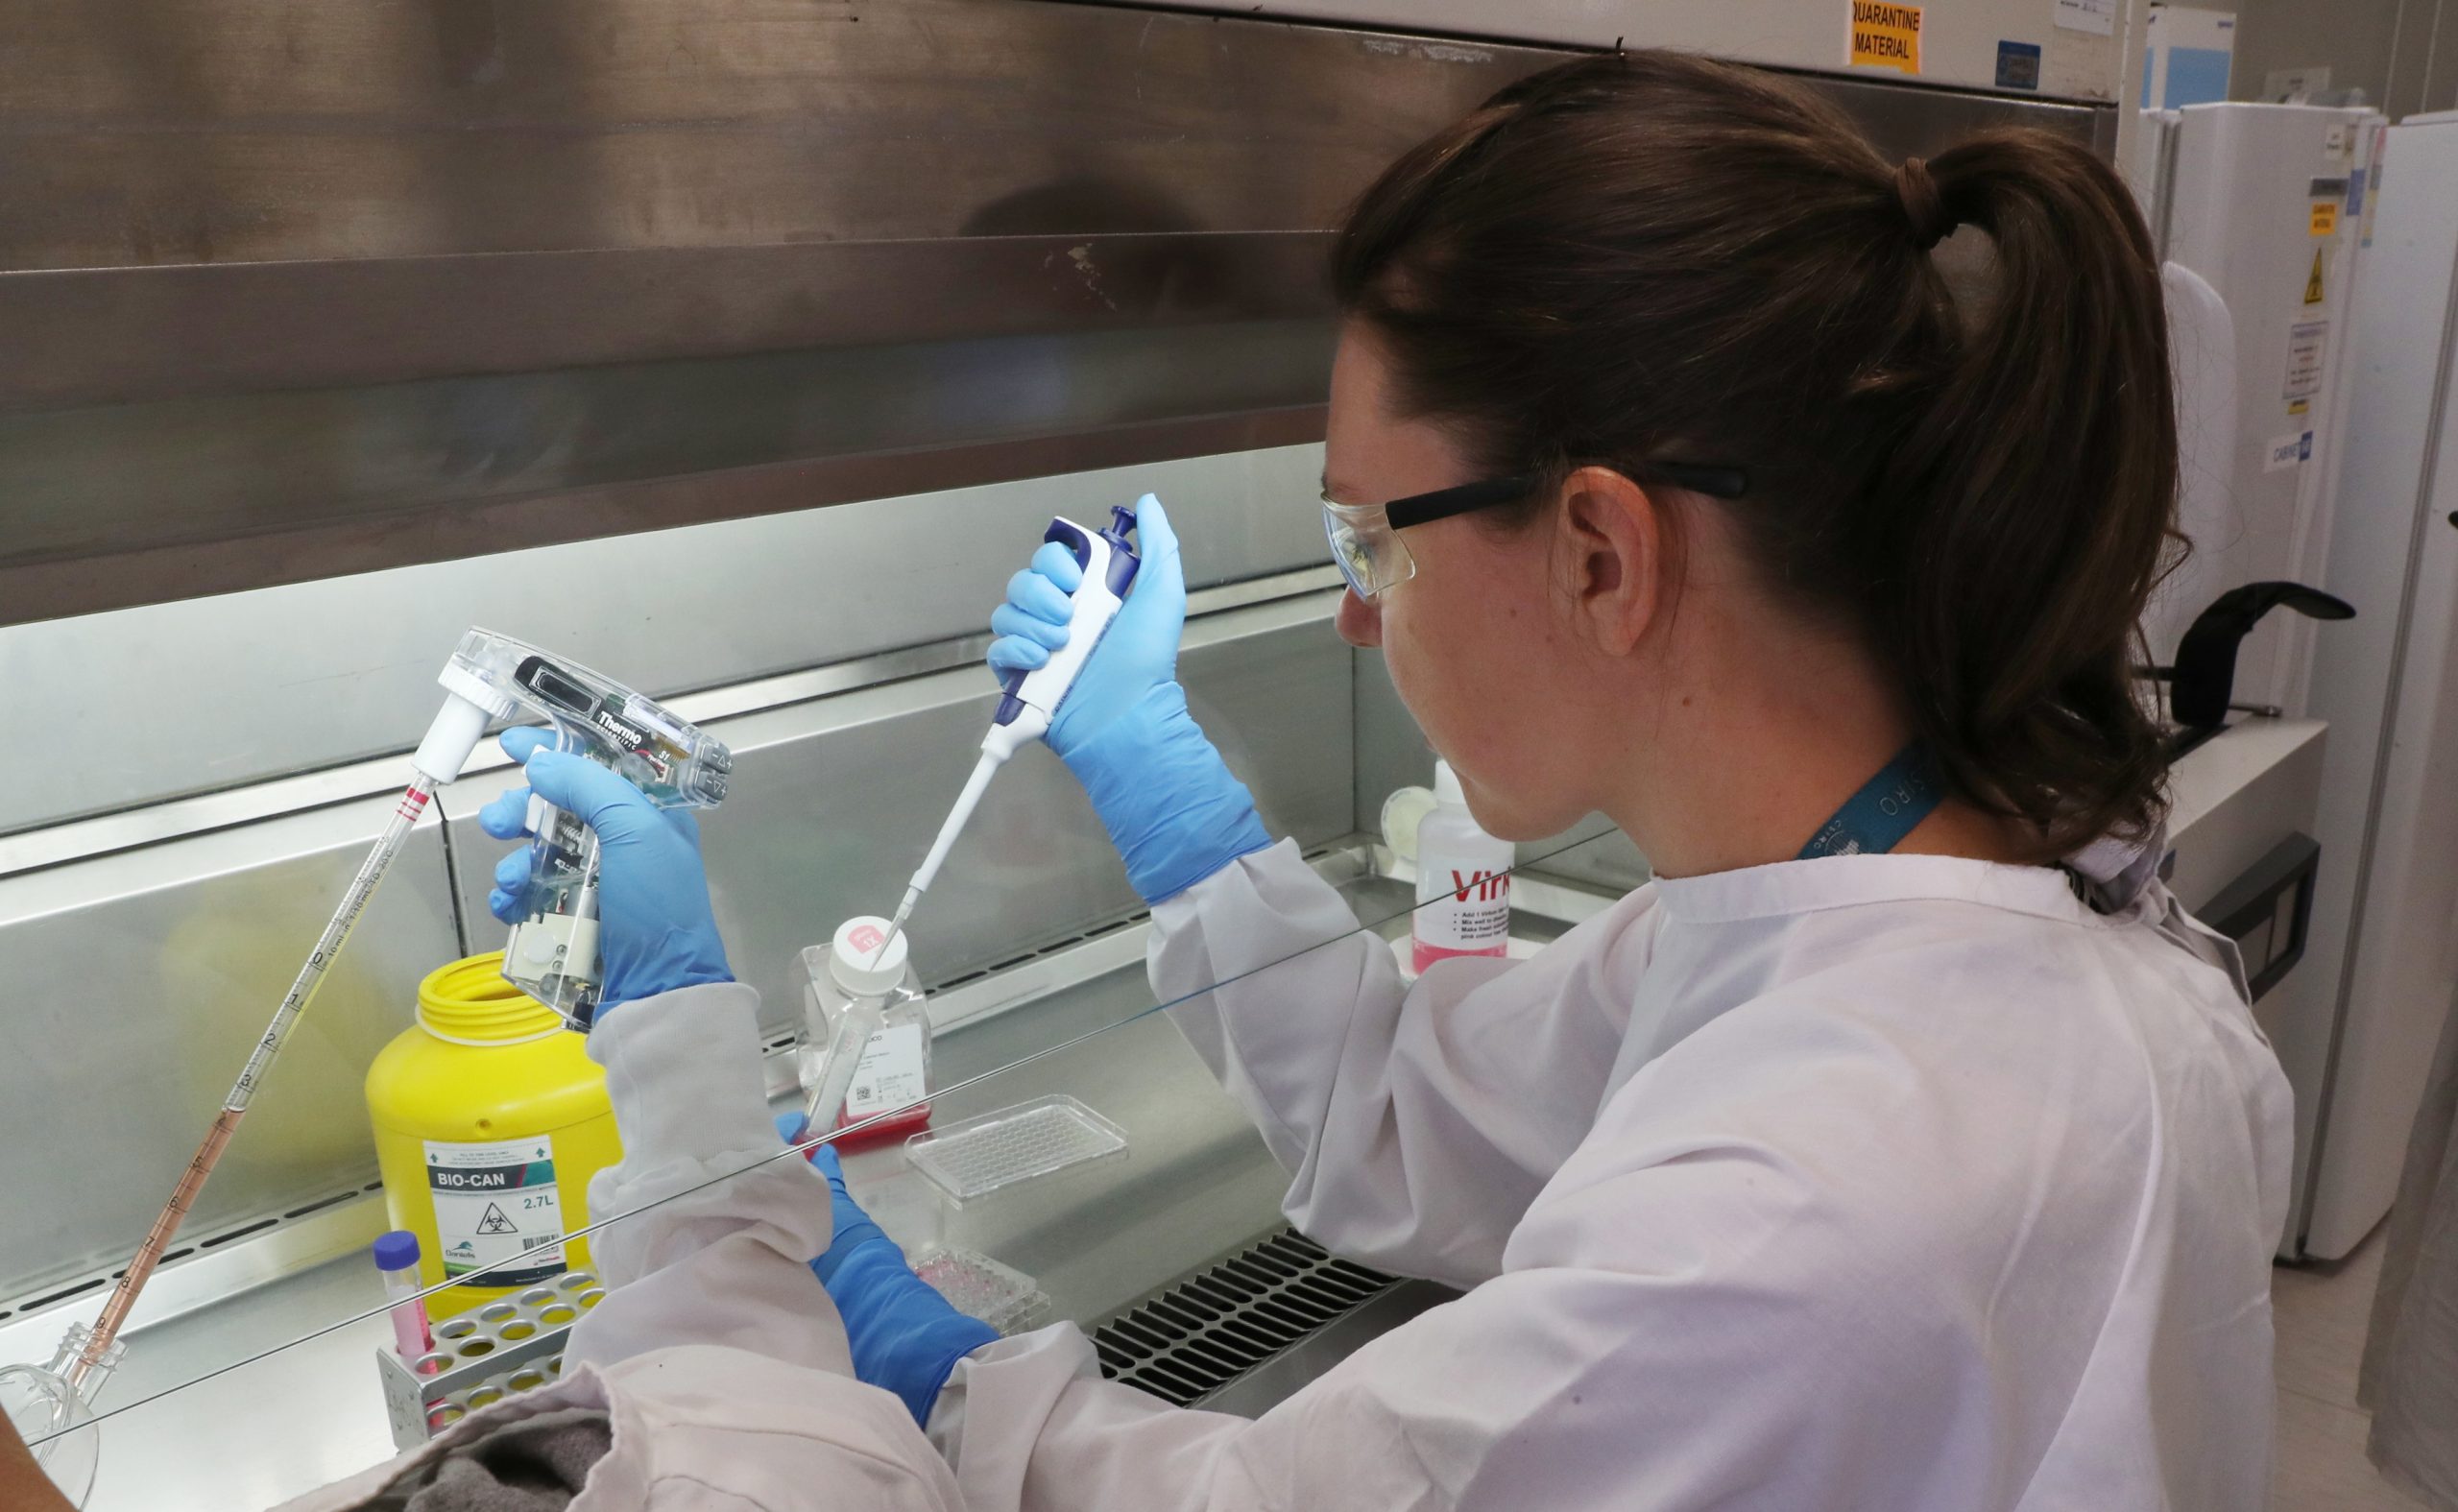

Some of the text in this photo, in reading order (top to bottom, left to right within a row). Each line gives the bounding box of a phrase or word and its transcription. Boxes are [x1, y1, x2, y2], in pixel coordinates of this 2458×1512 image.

[1854, 32, 1910, 59] MATERIAL
[598, 710, 642, 745] Thermo
[596, 725, 637, 751] SCIENTIFIC
[313, 951, 324, 964] 0
[291, 994, 299, 1004] 1
[264, 1033, 277, 1044] 2
[241, 1073, 252, 1087] 3
[437, 1173, 506, 1187] BIO-CAN
[170, 1196, 180, 1208] 6
[523, 1195, 554, 1210] 2.7L
[145, 1236, 156, 1247] 7
[121, 1276, 132, 1288] 8
[97, 1317, 107, 1330] 9
